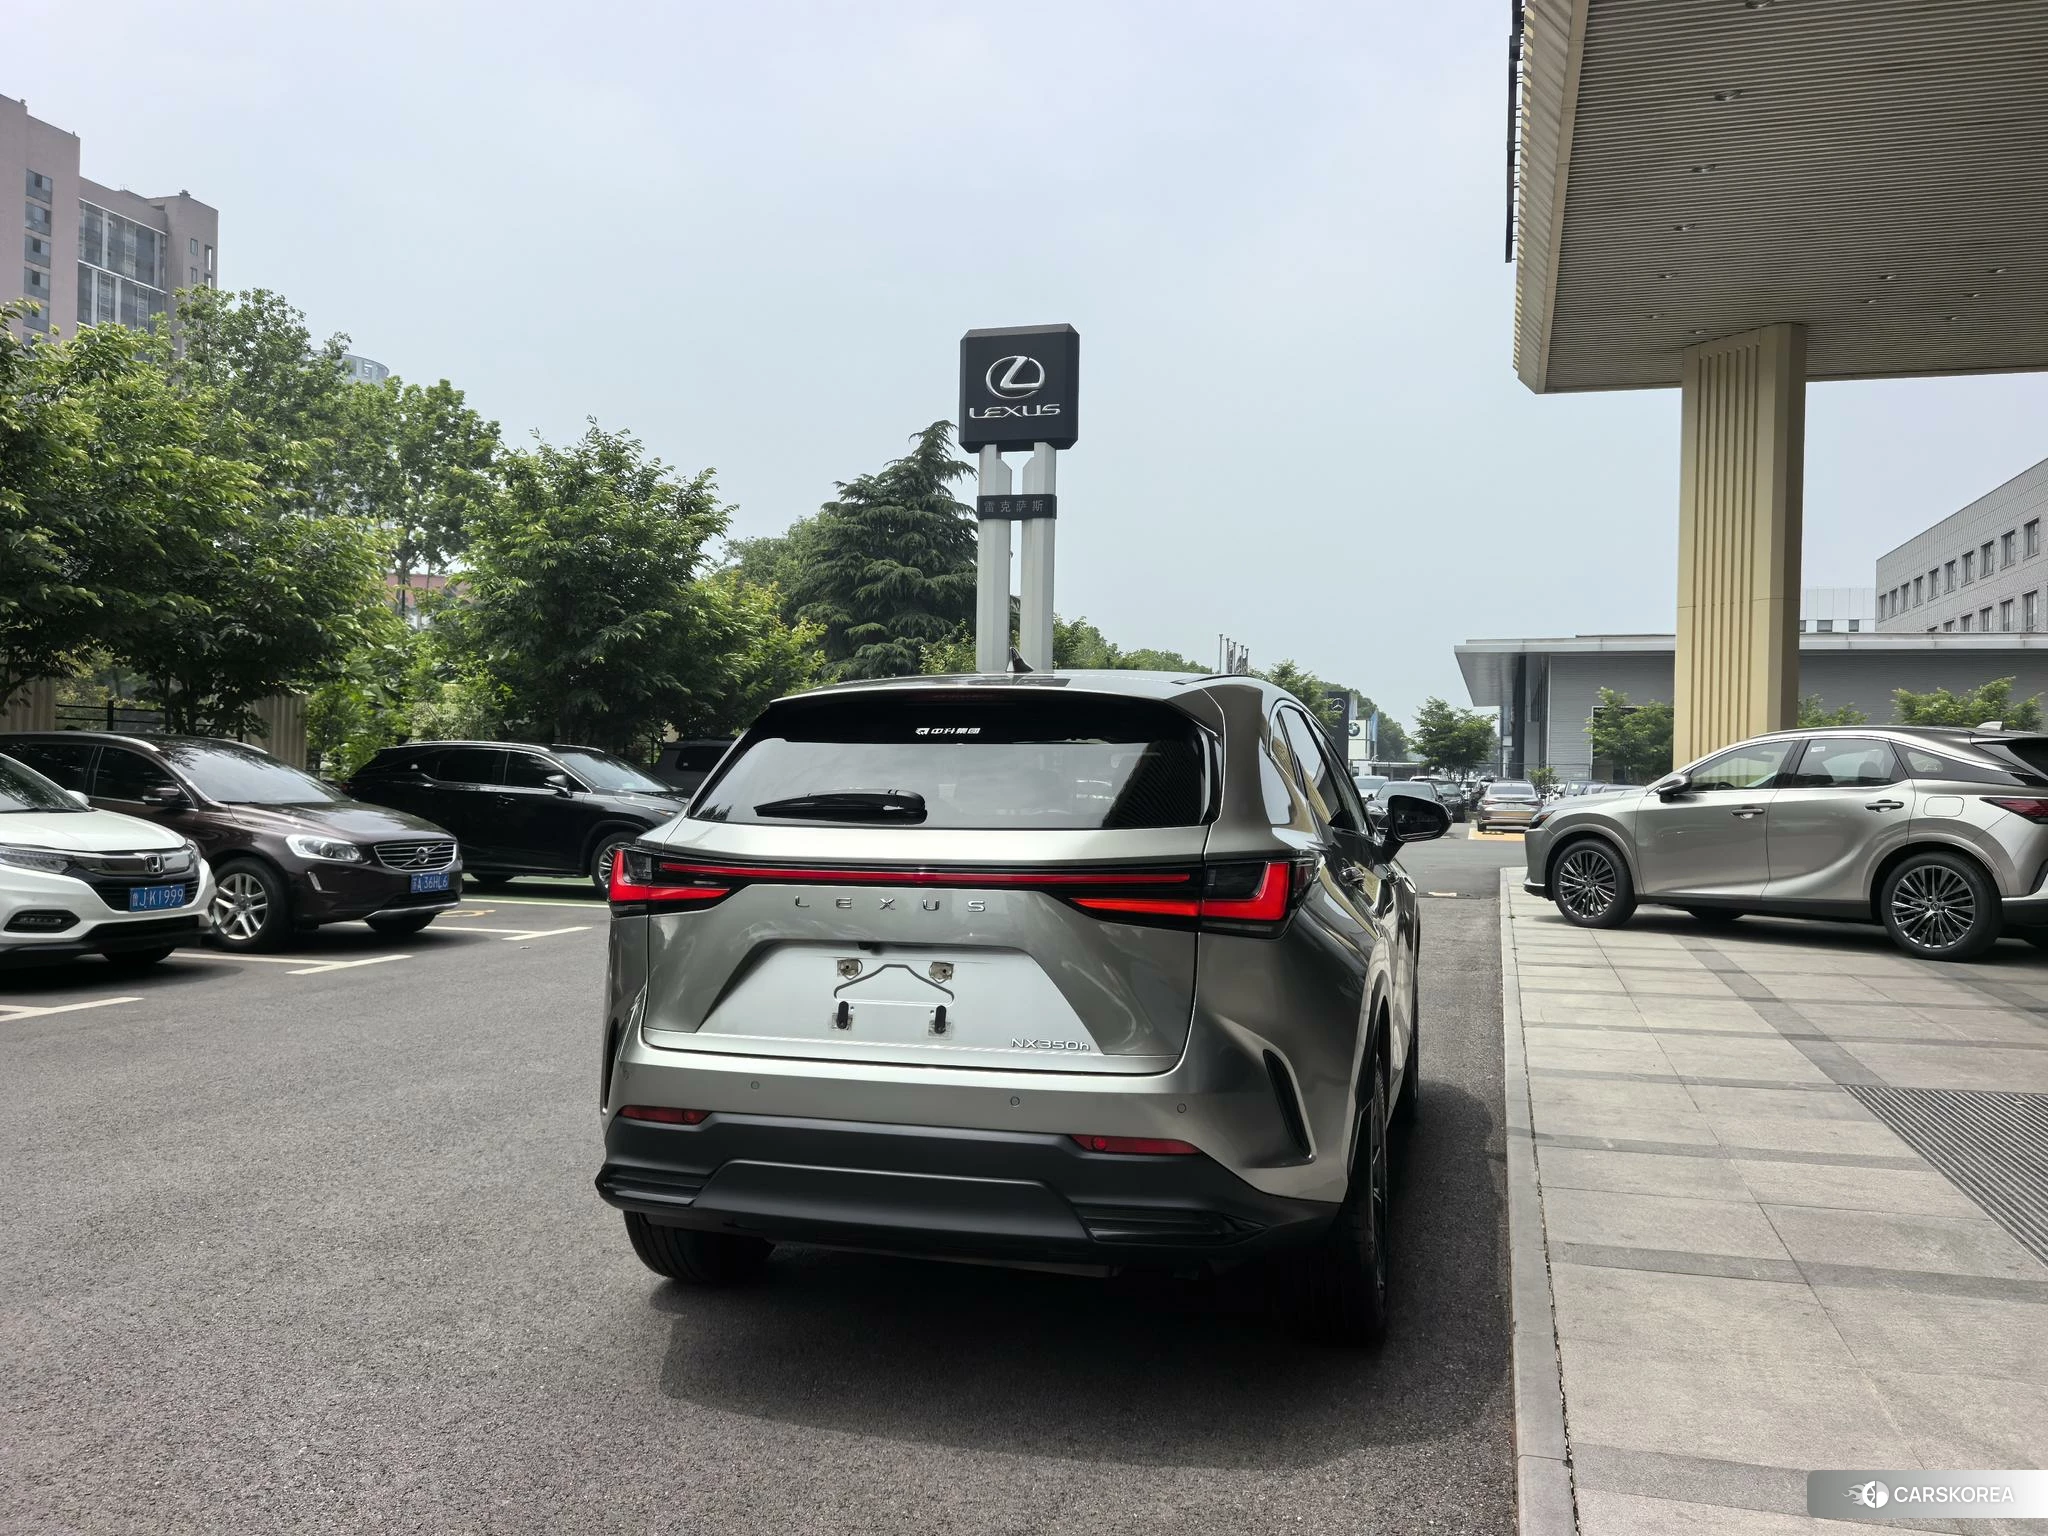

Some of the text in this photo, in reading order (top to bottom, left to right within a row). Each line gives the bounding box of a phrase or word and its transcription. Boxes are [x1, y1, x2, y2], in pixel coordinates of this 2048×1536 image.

[969, 403, 1061, 419] LEXUS
[983, 499, 1044, 513] 雷克萨斯
[794, 895, 986, 912] LEXUS
[1010, 1038, 1090, 1051] NX350h
